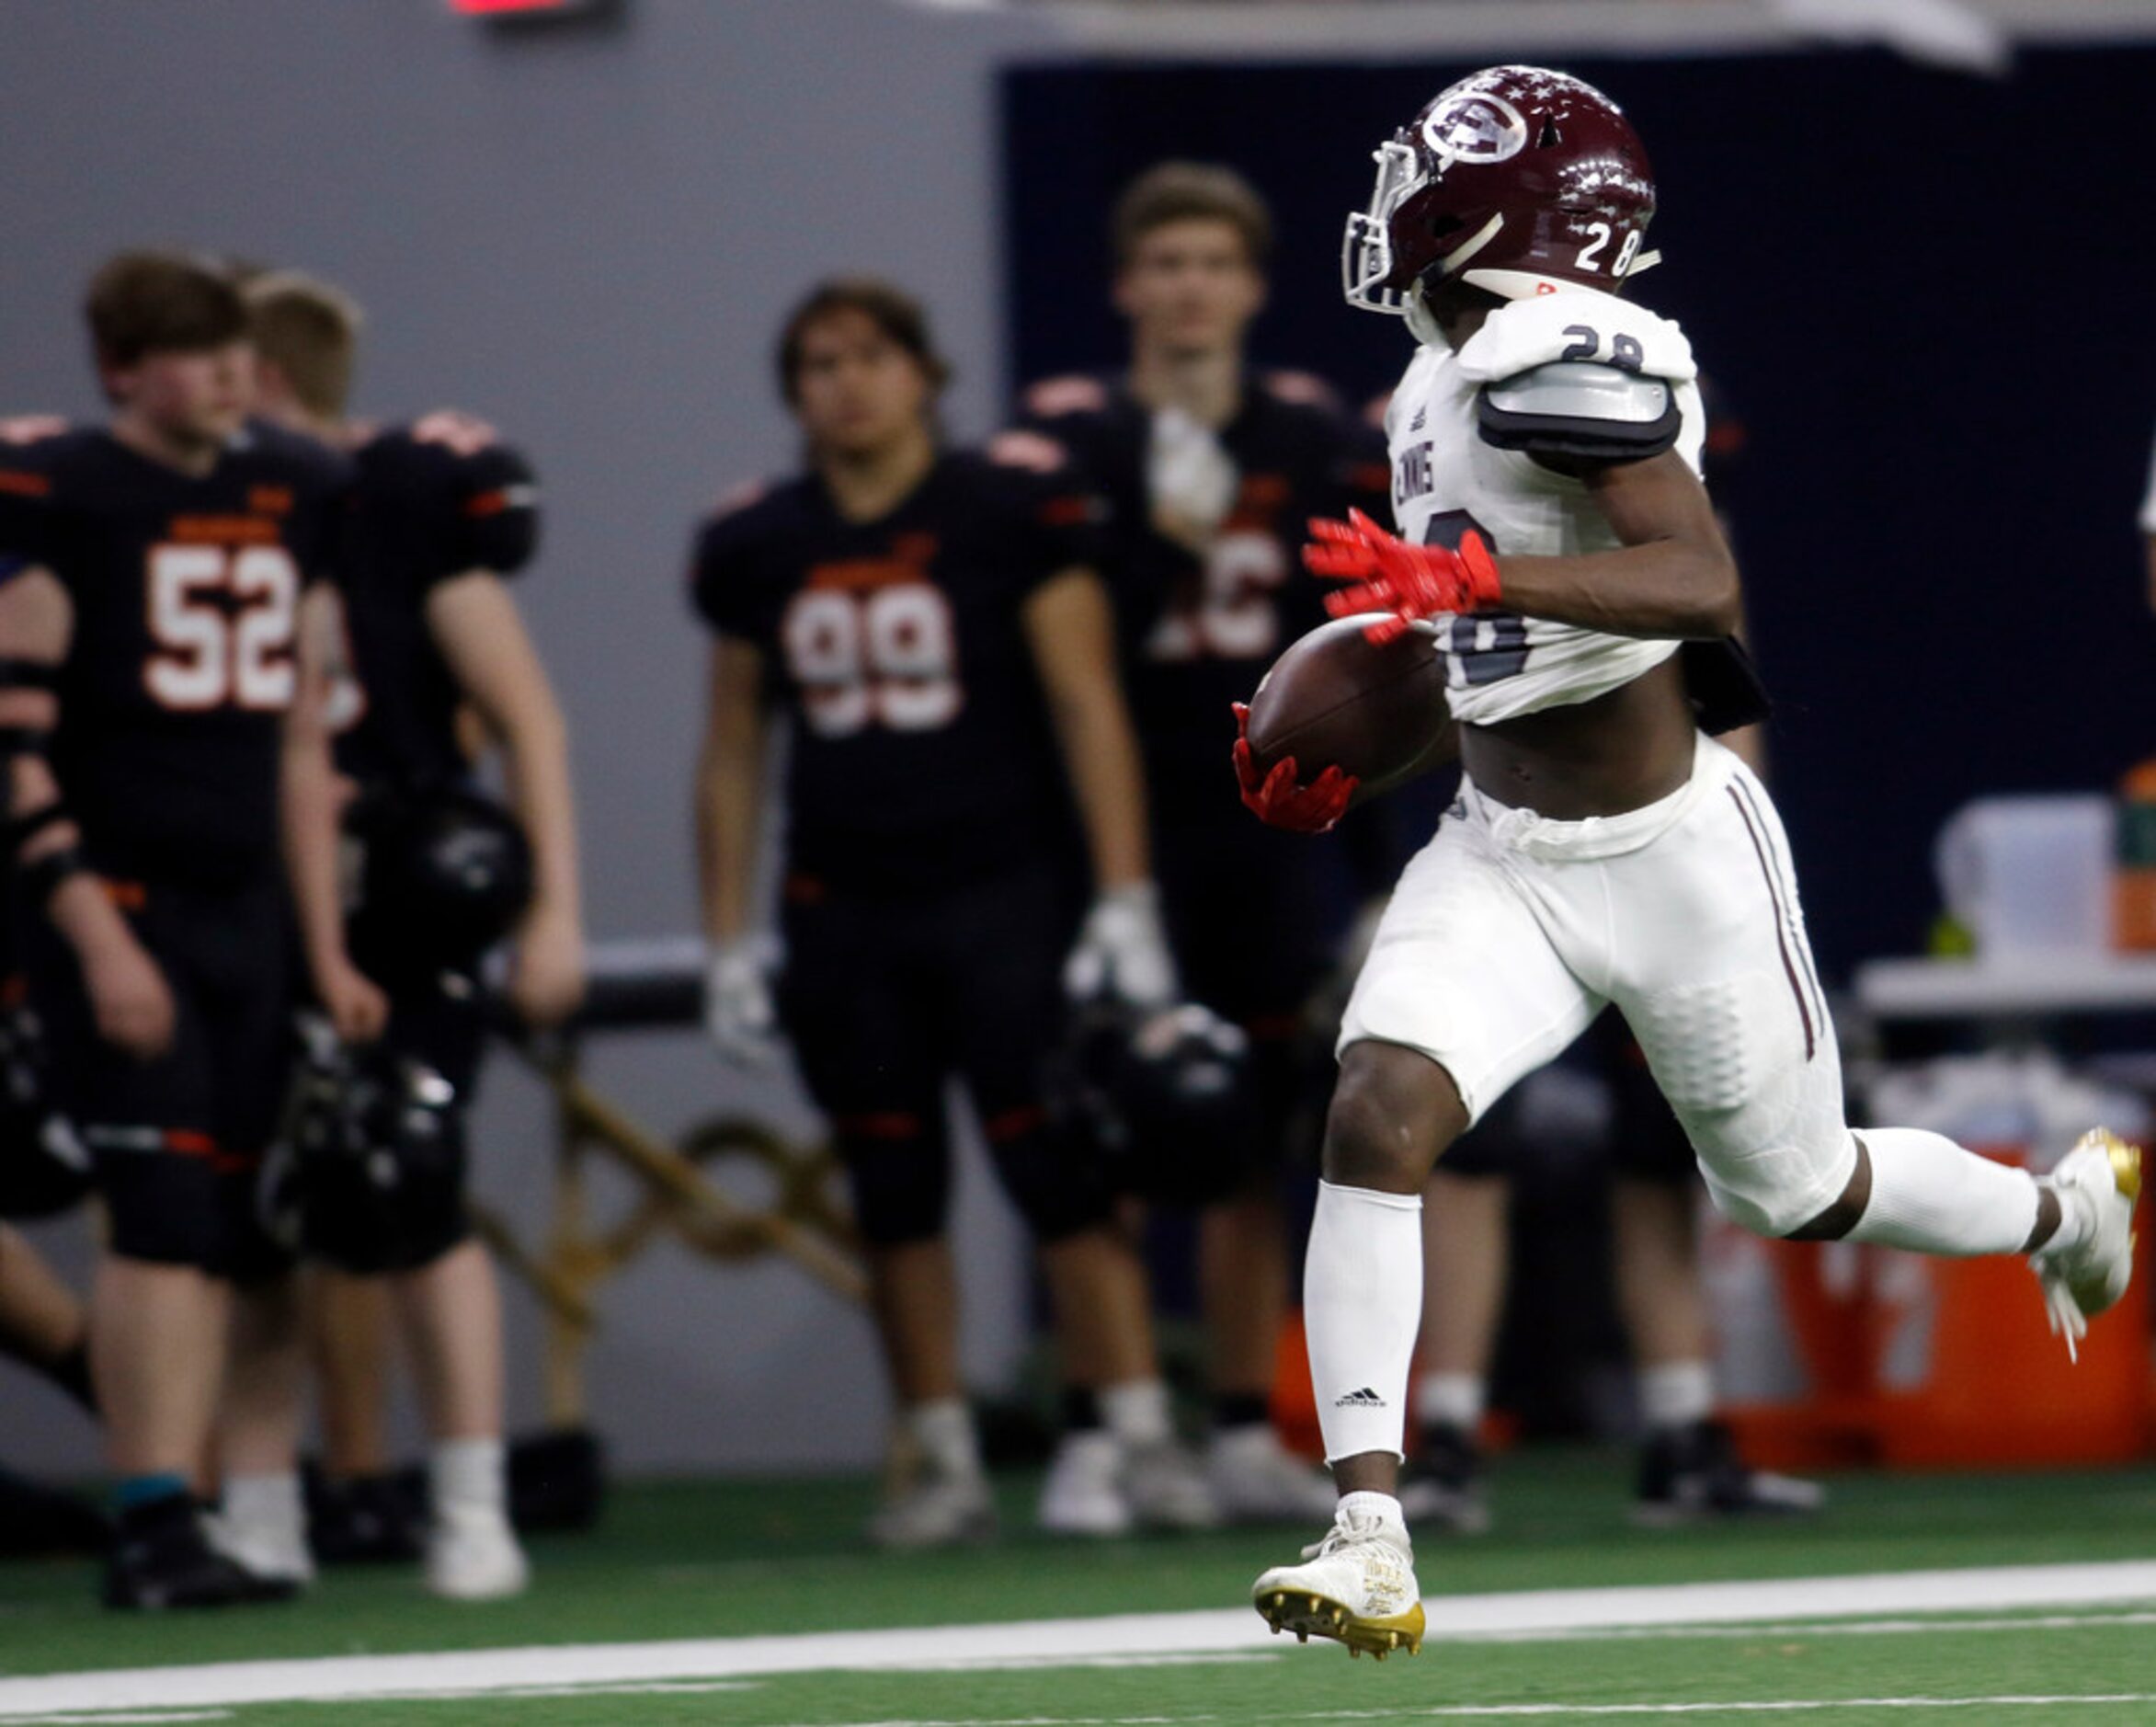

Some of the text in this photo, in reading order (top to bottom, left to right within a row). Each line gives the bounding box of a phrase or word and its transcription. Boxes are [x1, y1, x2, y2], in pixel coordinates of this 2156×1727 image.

[1574, 221, 1642, 277] 28
[143, 544, 302, 707] 52
[781, 583, 964, 736] 99
